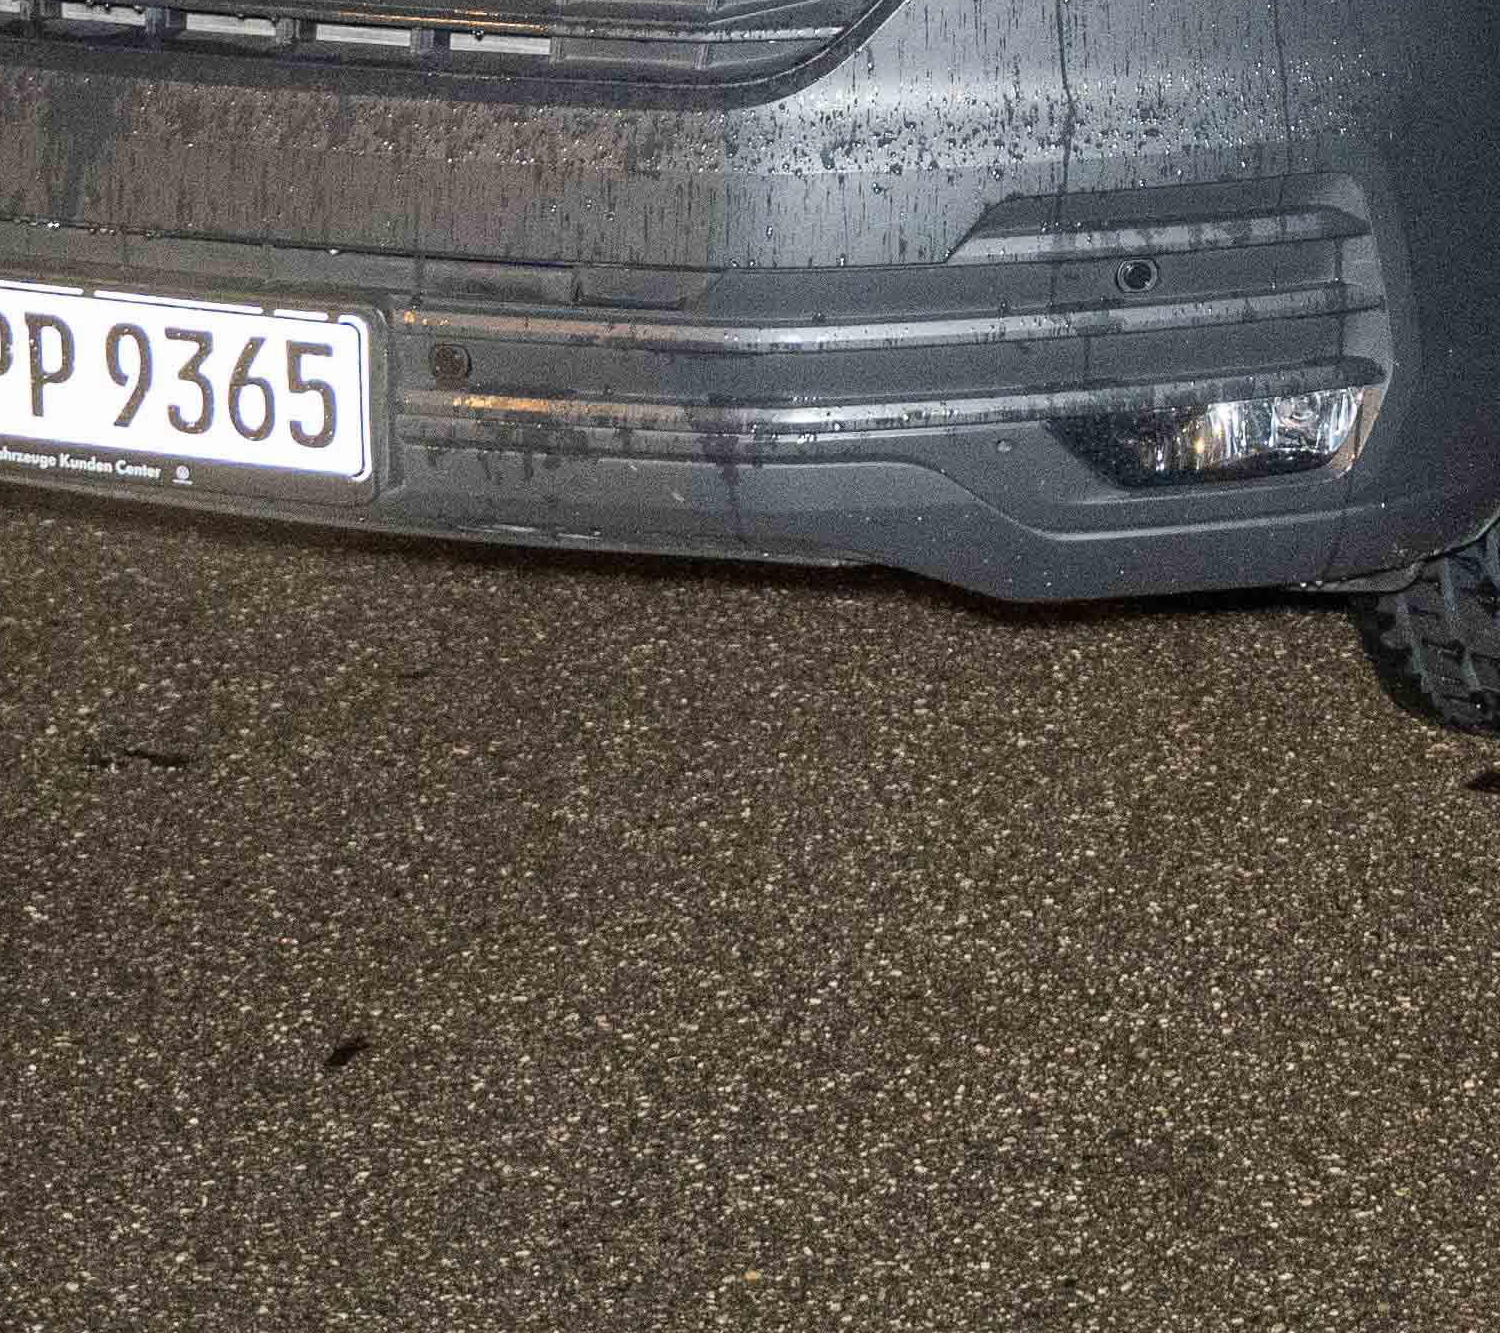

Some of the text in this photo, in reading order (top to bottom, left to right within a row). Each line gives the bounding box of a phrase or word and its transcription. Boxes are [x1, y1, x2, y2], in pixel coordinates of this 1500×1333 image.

[104, 322, 338, 449] 9365
[59, 452, 113, 474] Kunden
[116, 459, 162, 479] Center
